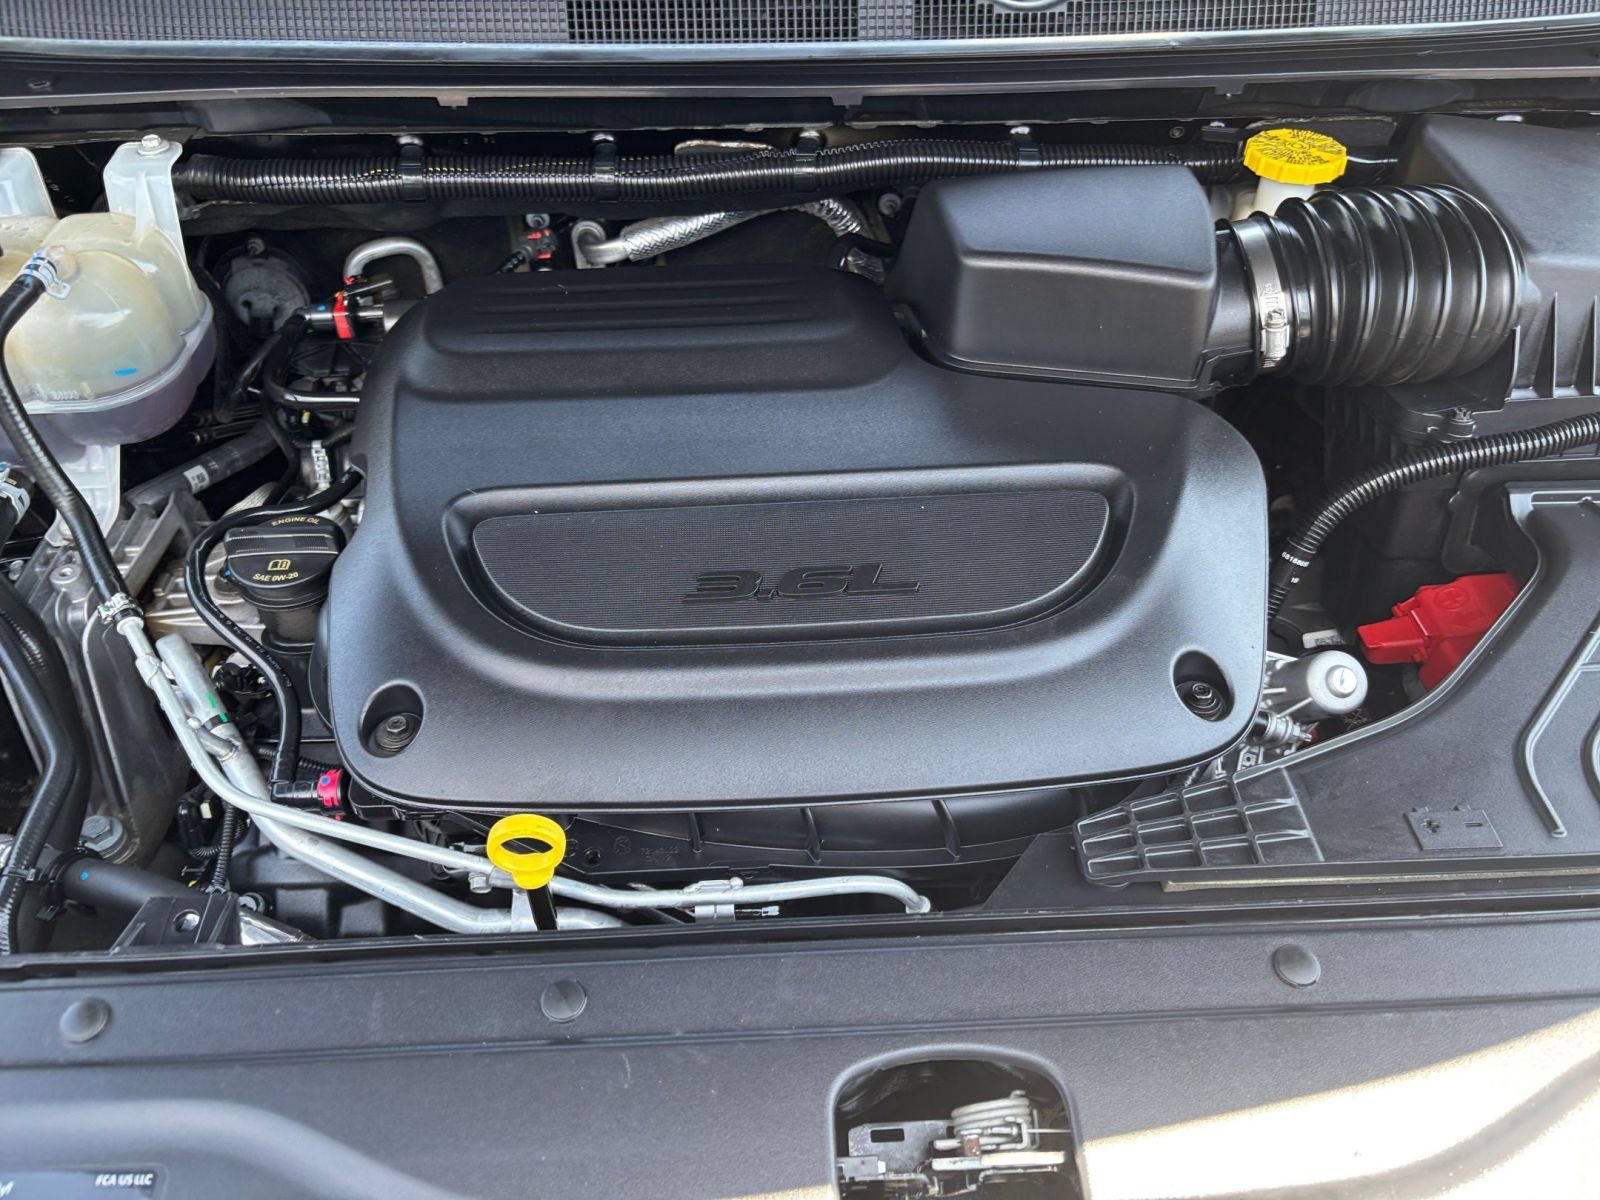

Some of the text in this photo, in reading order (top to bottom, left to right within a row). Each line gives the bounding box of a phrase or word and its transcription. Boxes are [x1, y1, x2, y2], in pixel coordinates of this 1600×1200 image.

[271, 516, 320, 526] ENGINE OIL
[252, 571, 299, 582] SAE 0W-20
[681, 562, 921, 605] 3.6L
[95, 1173, 154, 1187] FCA US LLC
